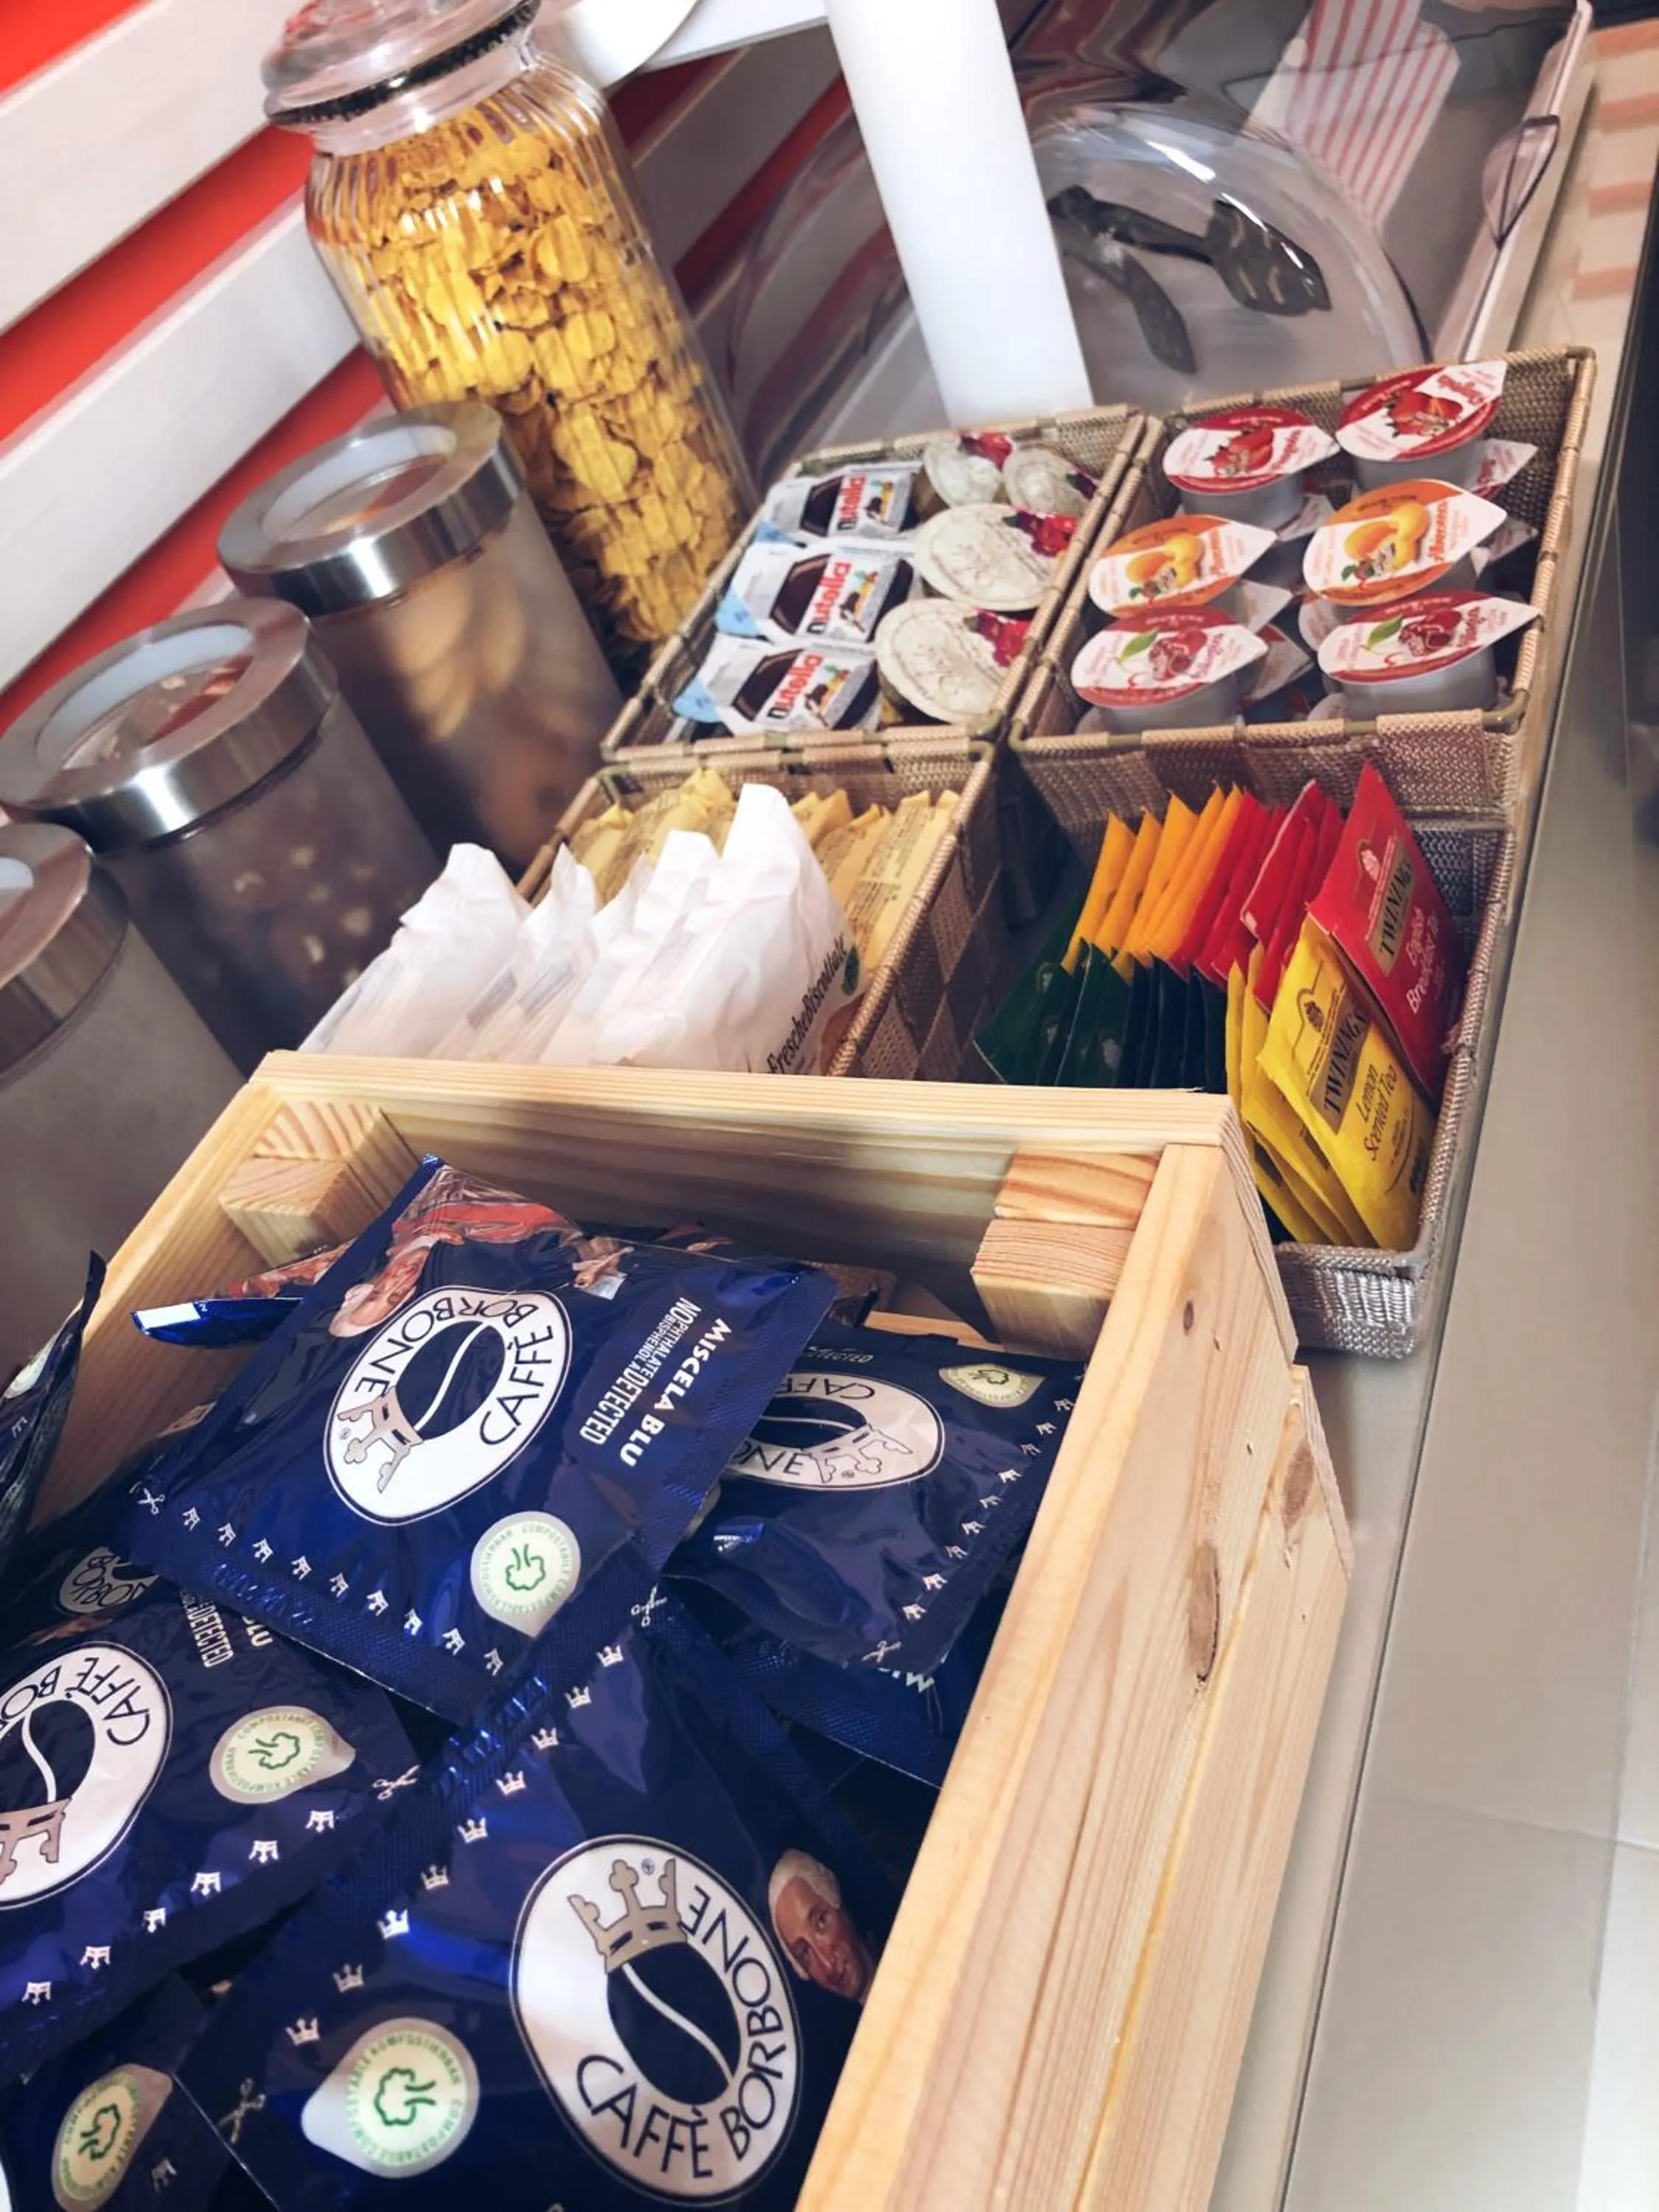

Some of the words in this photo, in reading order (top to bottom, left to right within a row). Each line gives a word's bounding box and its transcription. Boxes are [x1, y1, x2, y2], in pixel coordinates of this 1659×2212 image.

[807, 562, 852, 634] nutella
[767, 653, 823, 720] nutella
[1324, 1007, 1369, 1114] TWININGS
[1357, 1063, 1378, 1121] Lemon
[1364, 1088, 1389, 1161] Scented
[1380, 1064, 1397, 1096] Tea
[668, 1297, 701, 1326] NO
[355, 1298, 540, 1397] BORBONE
[639, 1321, 687, 1379] PHTHALATE
[653, 1318, 731, 1408] MISCELA
[579, 1367, 649, 1447] DETECTED
[776, 1377, 875, 1399] CAFF
[622, 1413, 664, 1467] BLU
[187, 1604, 234, 1668] DETECTED
[678, 1885, 787, 2161] BORBONE
